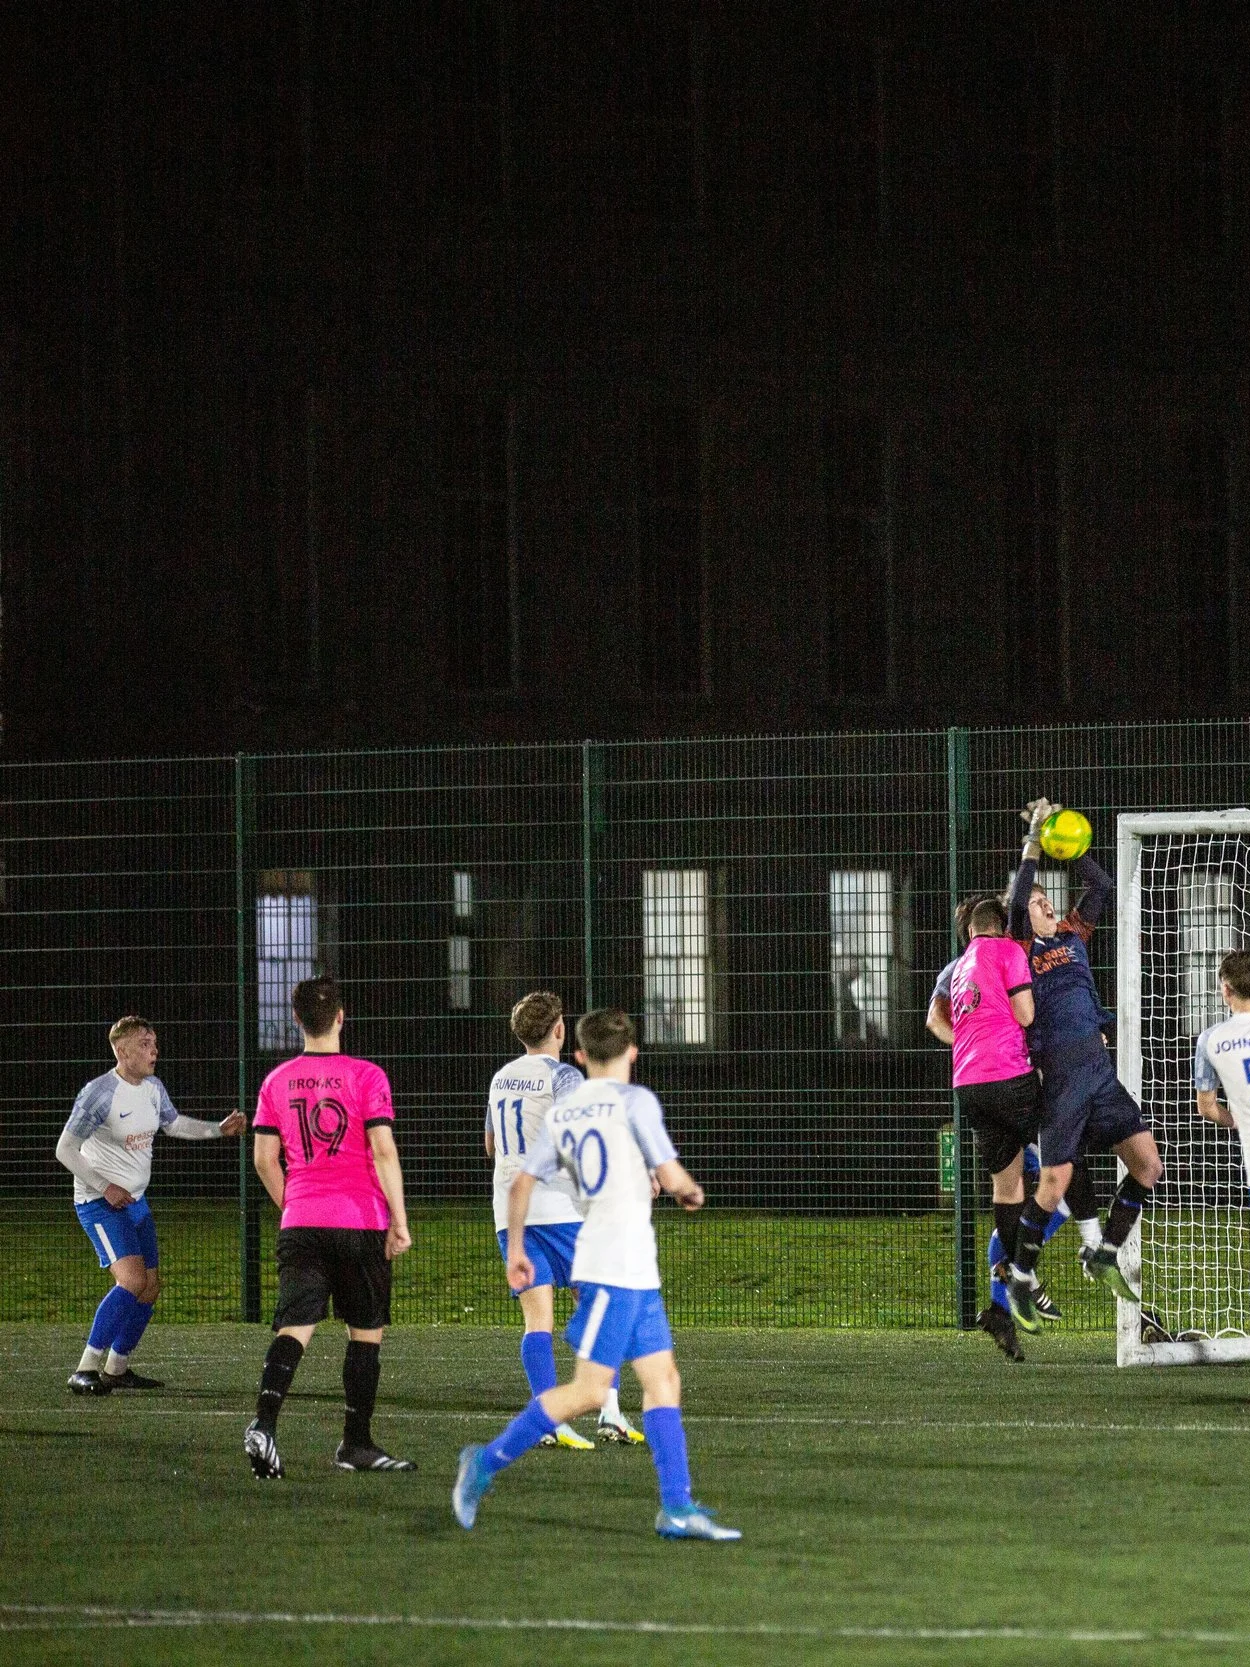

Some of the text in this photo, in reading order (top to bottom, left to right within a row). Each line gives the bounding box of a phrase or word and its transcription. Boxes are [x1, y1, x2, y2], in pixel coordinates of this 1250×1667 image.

[492, 1078, 545, 1091] RUNEWALD
[289, 1098, 348, 1165] 19
[497, 1097, 526, 1156] 11
[553, 1103, 616, 1123] LOCKETT
